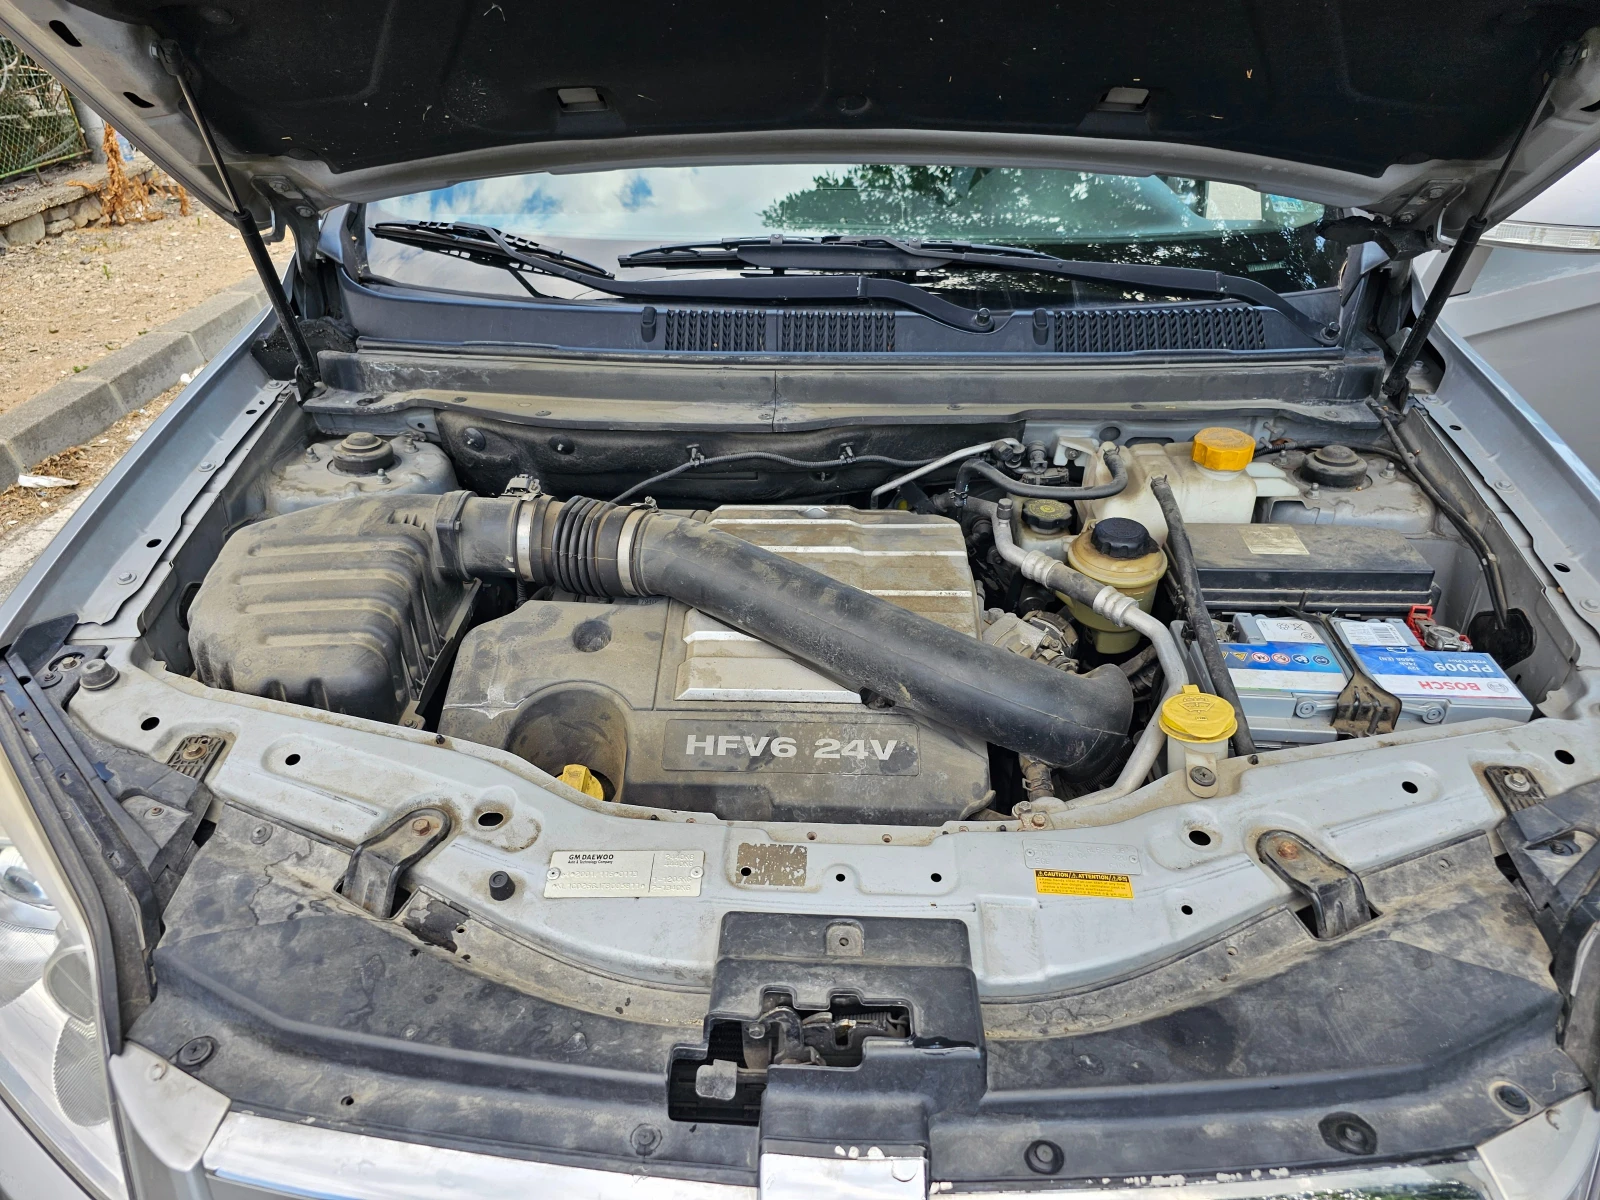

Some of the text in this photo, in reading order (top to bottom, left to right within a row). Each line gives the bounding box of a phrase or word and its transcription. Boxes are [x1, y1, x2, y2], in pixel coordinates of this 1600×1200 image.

[1434, 662, 1494, 673] PP009
[1418, 680, 1481, 691] BOSCH
[685, 734, 898, 761] HFV6 24V
